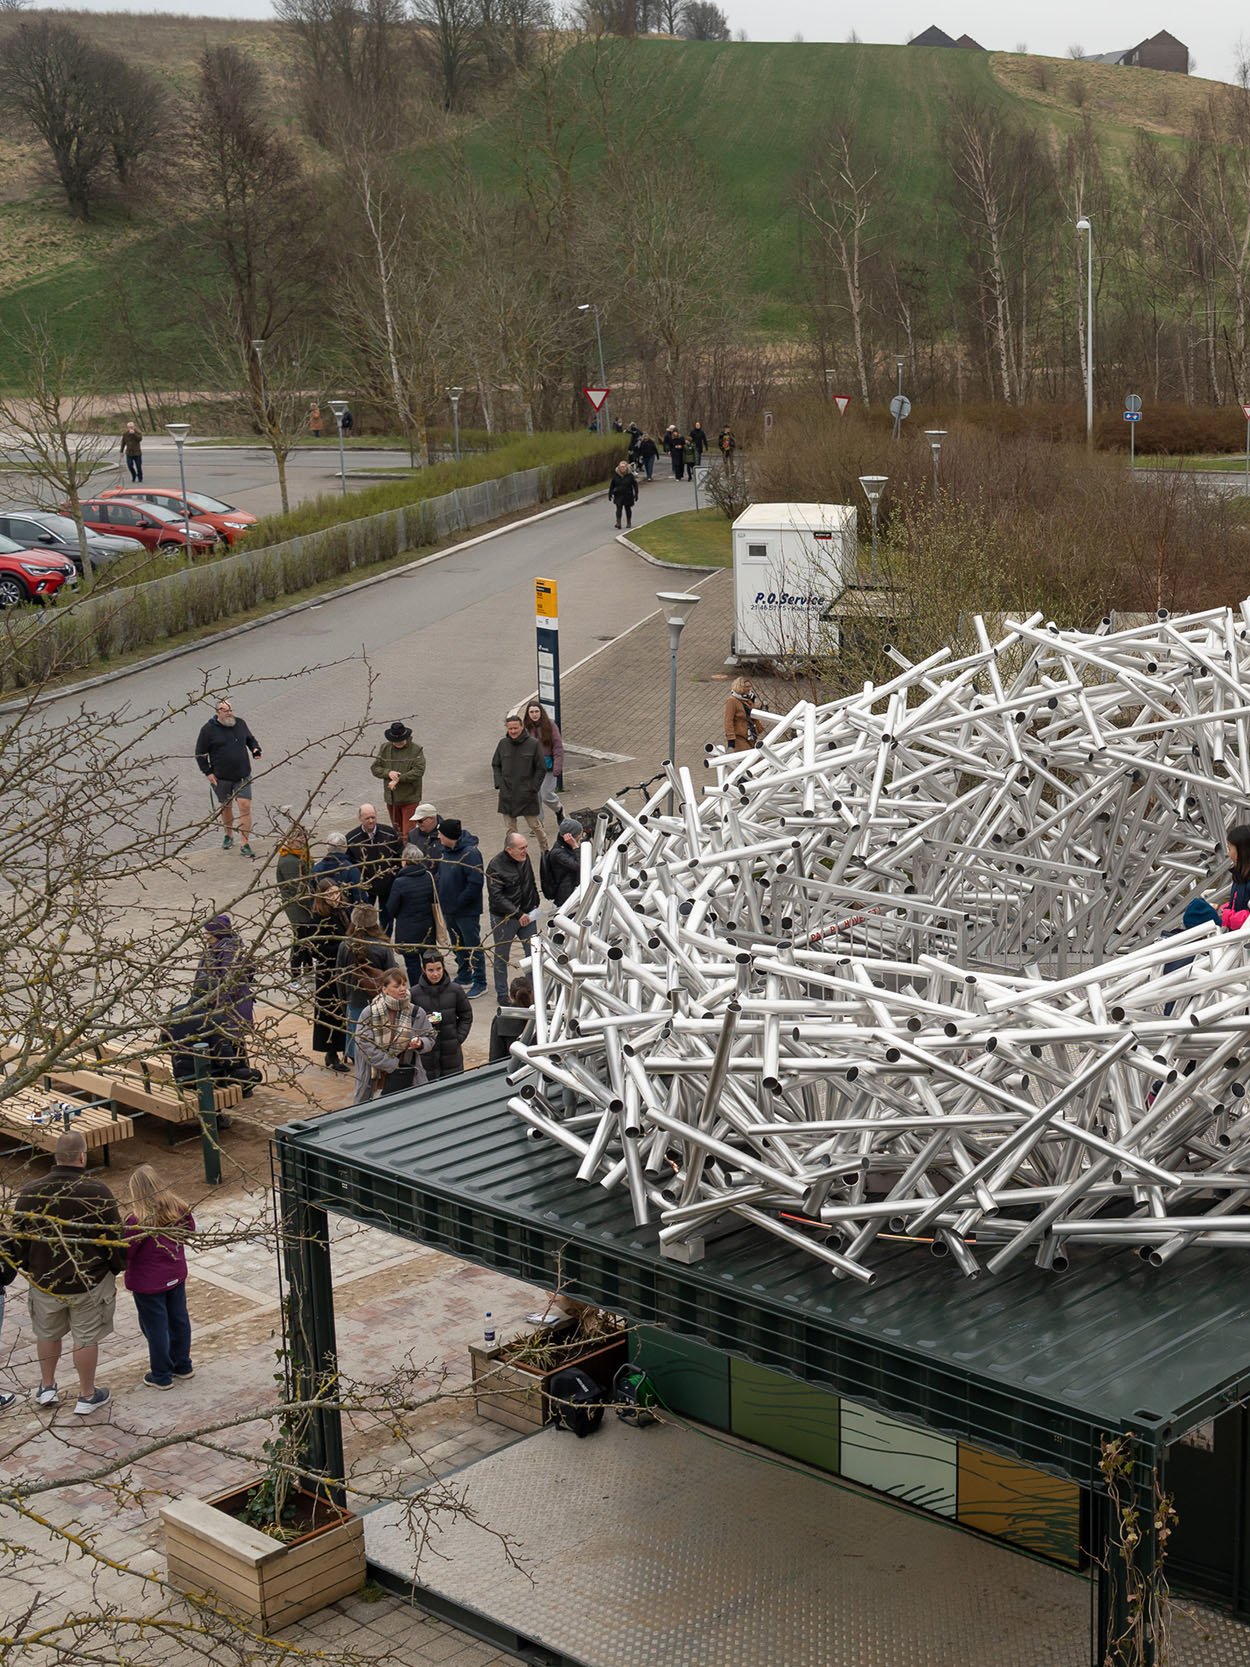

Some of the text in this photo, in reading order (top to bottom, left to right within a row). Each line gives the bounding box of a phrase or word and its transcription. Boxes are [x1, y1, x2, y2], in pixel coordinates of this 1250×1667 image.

[755, 592, 825, 606] P.O.Service
[810, 929, 826, 942] PA
[829, 924, 840, 935] P
